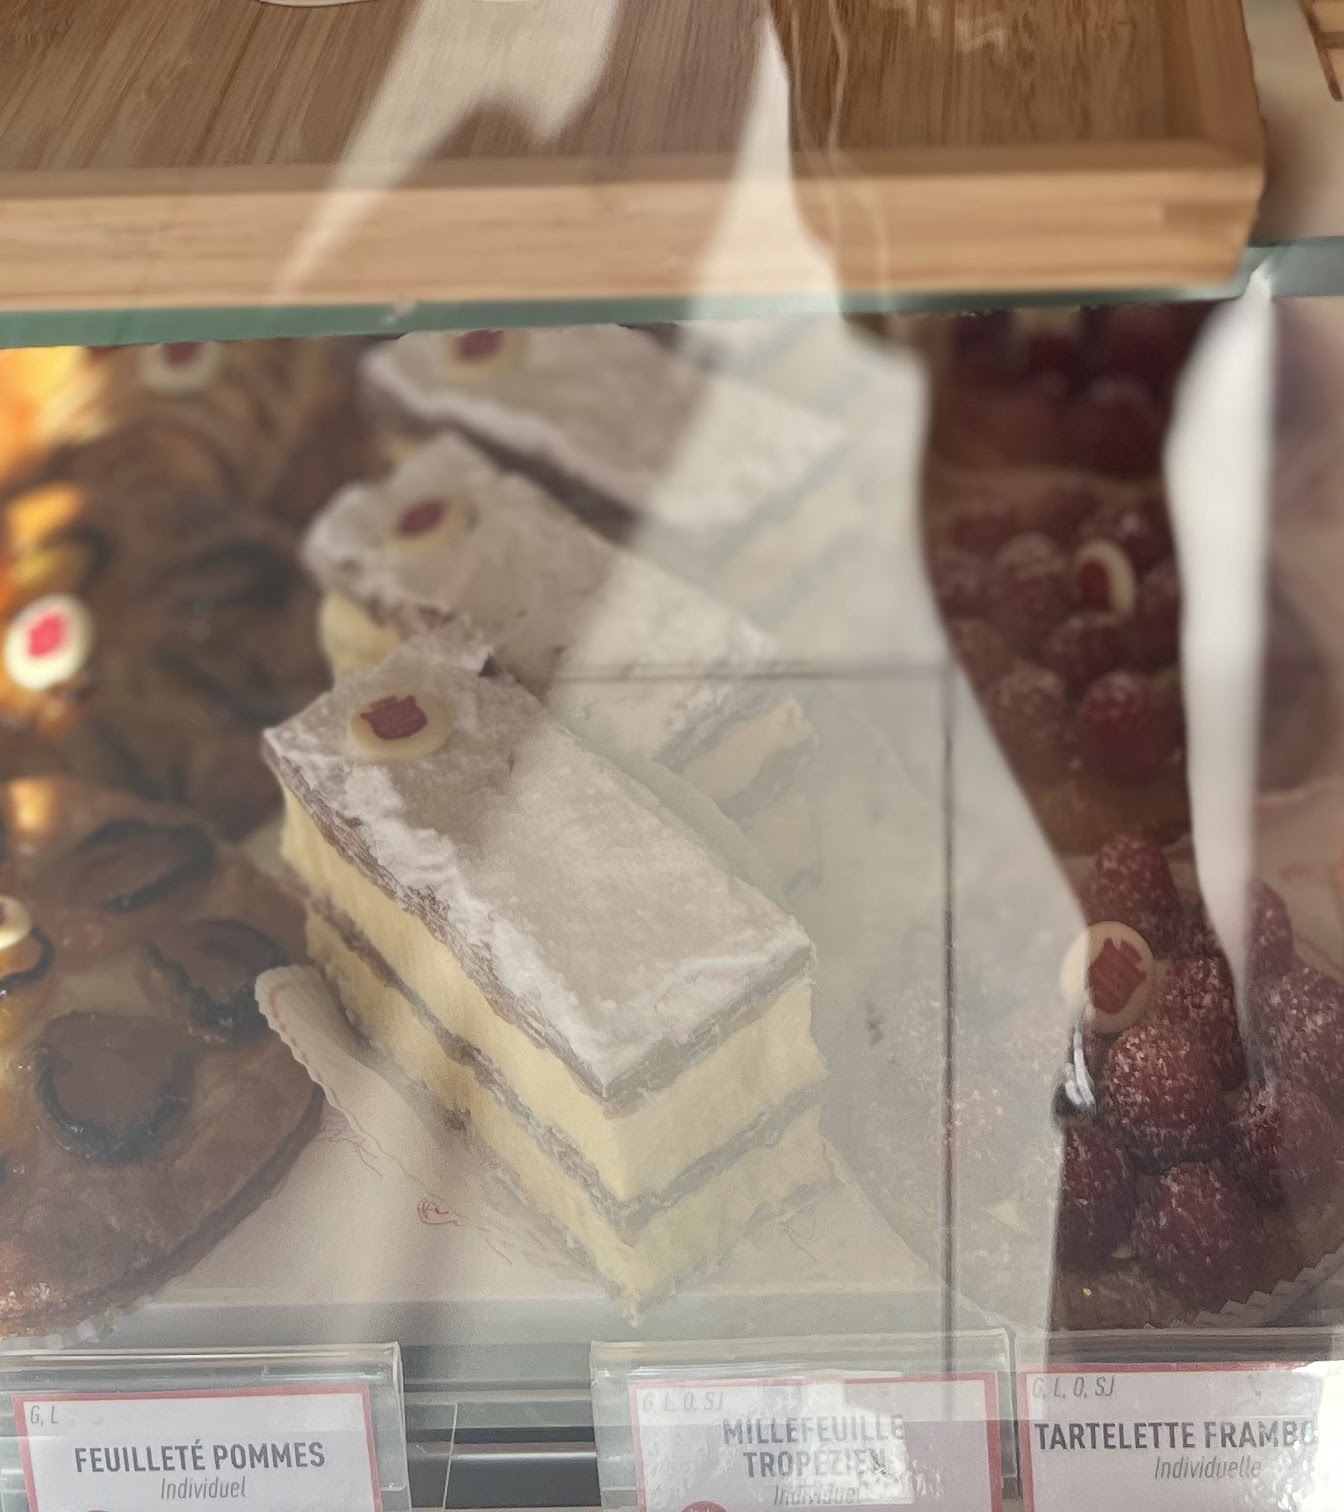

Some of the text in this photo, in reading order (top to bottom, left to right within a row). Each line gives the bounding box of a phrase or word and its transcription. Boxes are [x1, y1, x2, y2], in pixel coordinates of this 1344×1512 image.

[722, 1414, 905, 1445] MILLEFEUILLE
[1035, 1419, 1318, 1450] TARTELETTE FRAMBO
[74, 1439, 326, 1473] FEUILLETÉ POMMES
[1154, 1453, 1262, 1481] Individuelle
[160, 1476, 247, 1500] Individuel
